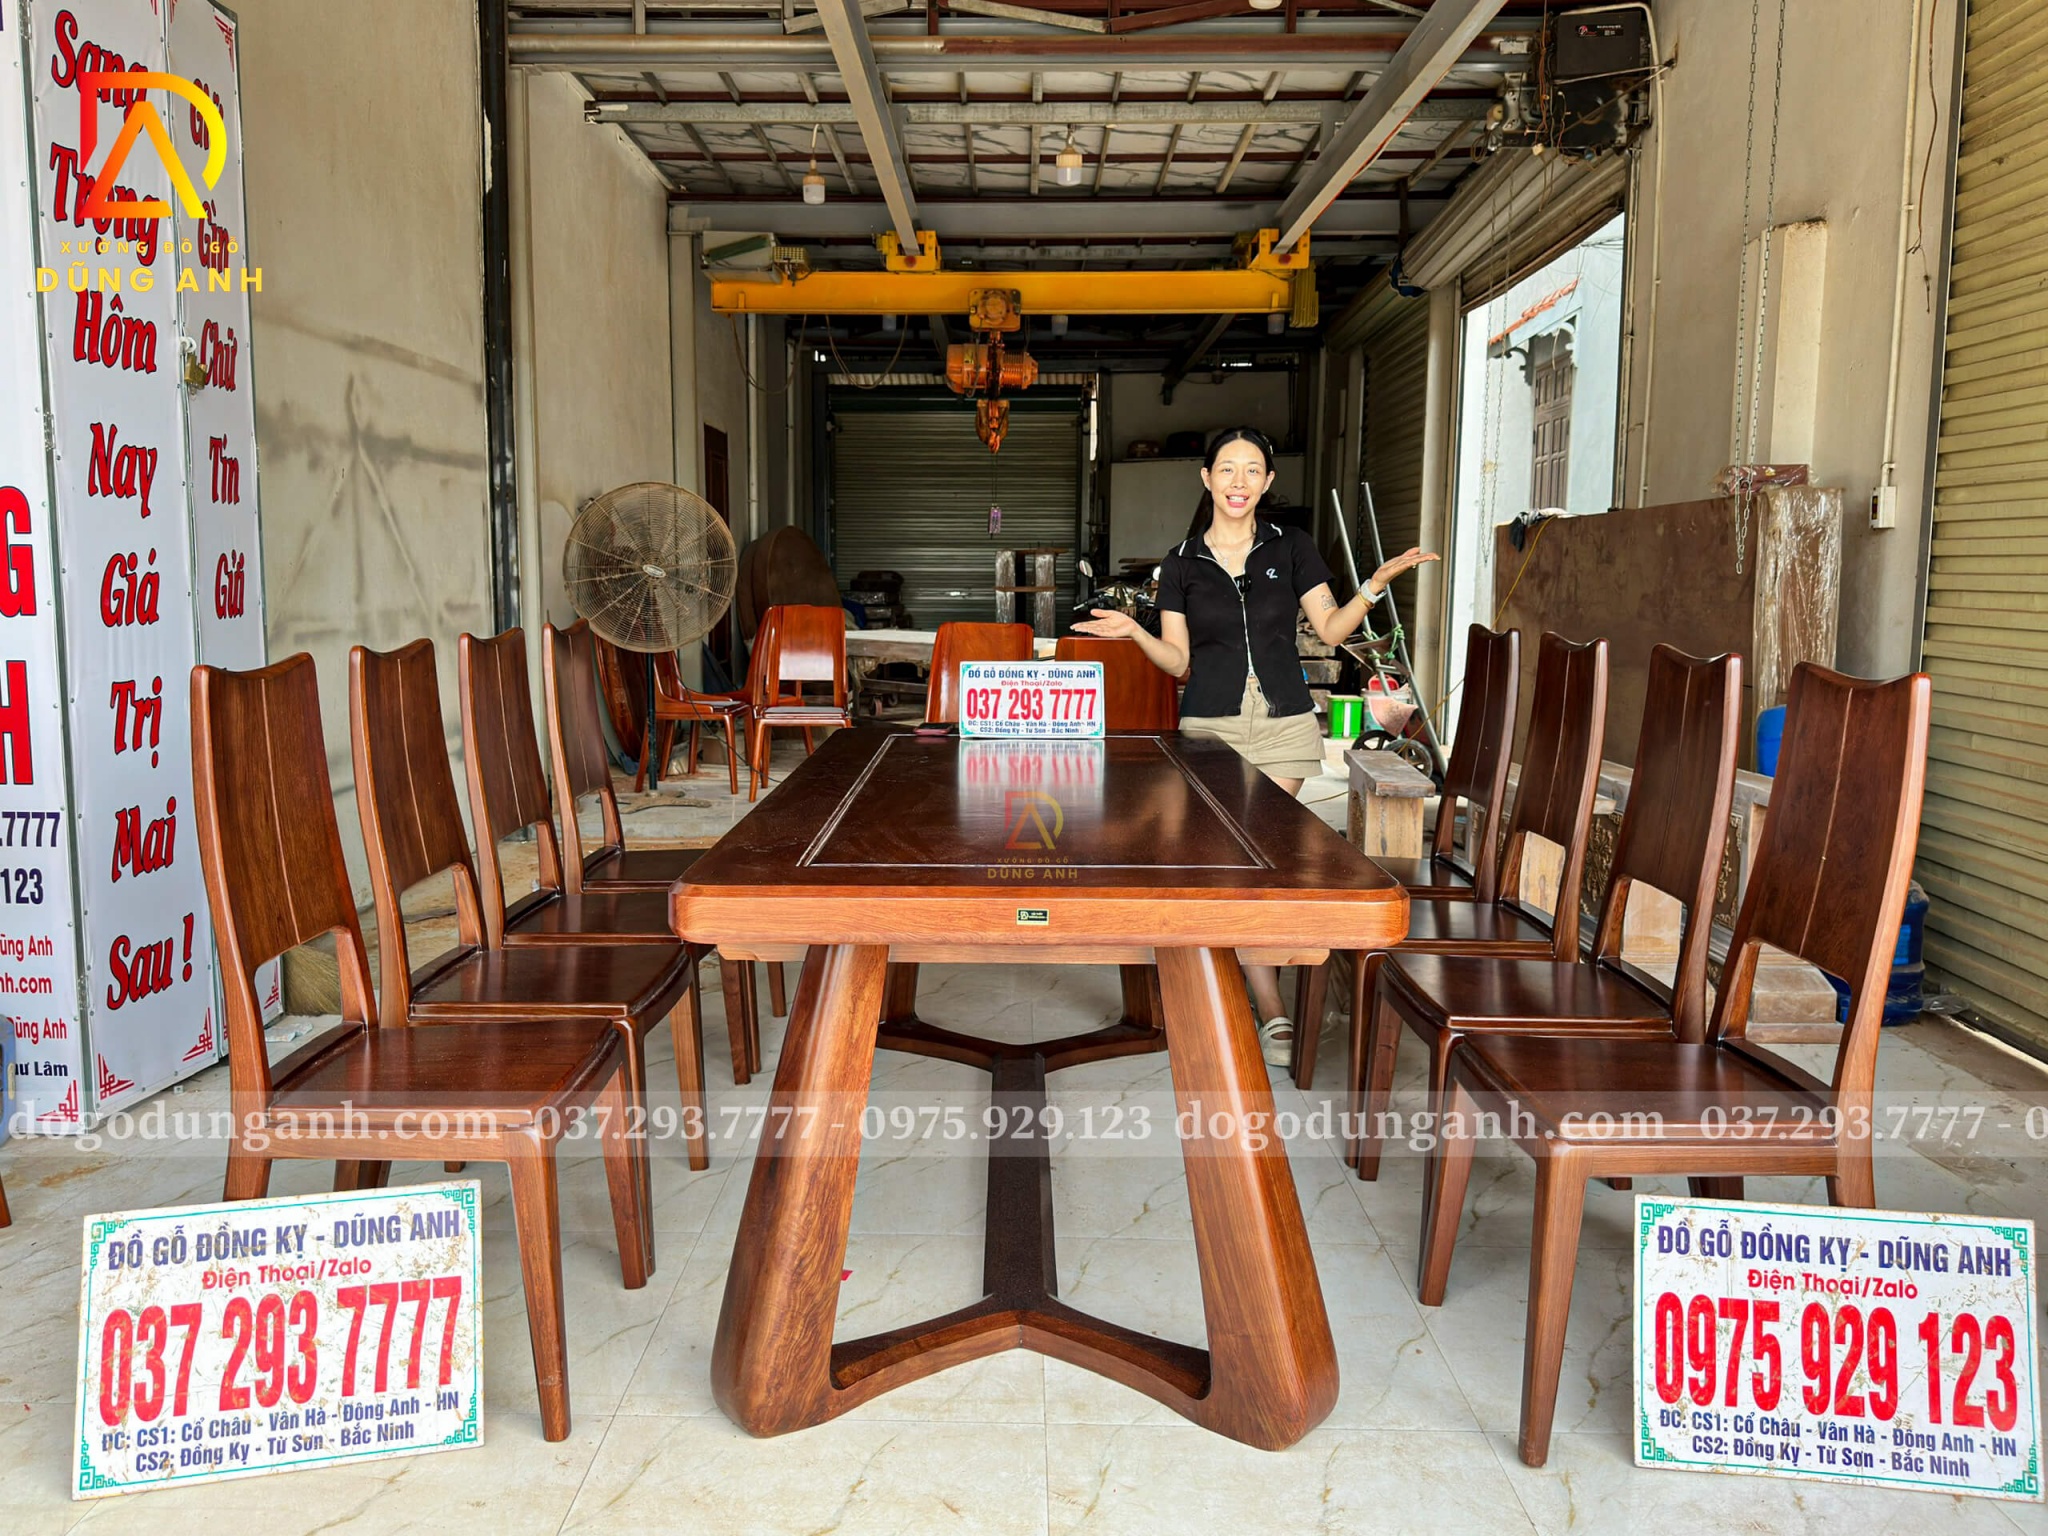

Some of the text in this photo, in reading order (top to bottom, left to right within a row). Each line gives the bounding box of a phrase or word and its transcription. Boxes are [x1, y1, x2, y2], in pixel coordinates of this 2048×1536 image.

[190, 78, 224, 151] Gi
[74, 288, 157, 374] Hôm
[88, 422, 158, 519] Nay
[209, 434, 241, 505] Tín
[100, 547, 160, 628] Giá
[967, 688, 1097, 720] 037 293 7777
[1076, 670, 1096, 679] ANH
[110, 675, 163, 769] Trị
[111, 796, 177, 883] Mai
[0, 868, 43, 905] 123
[28, 935, 53, 956] Anh
[6, 1016, 67, 1045] ũng Anh
[34, 1061, 68, 1077] Lâm
[108, 1229, 143, 1270] ĐỒ
[153, 1224, 188, 1266] GỖ
[196, 1221, 267, 1262] ĐỒNG
[276, 1224, 308, 1259] KỴ
[334, 1212, 401, 1249] DŨNG
[410, 1209, 460, 1241] ANH
[1657, 1217, 1690, 1255] ĐỒ
[1700, 1219, 1732, 1258] GỖ
[1740, 1223, 1810, 1263] ĐỒNG
[1819, 1236, 1851, 1272] KỴ
[1878, 1235, 1949, 1273] DŨNG
[1957, 1245, 2011, 1277] ANH
[202, 1256, 372, 1293] Điện Thoại/Zalo
[1747, 1269, 1918, 1300] Điện Thoại/Zalo
[99, 1276, 462, 1427] 037 293 7777
[1655, 1292, 2018, 1432] 0975 929 123
[102, 1431, 131, 1451] ĐC:
[137, 1426, 175, 1447] CS1:
[181, 1417, 205, 1442] Cổ
[209, 1416, 252, 1439] Châu
[269, 1411, 300, 1432] Vân
[305, 1407, 326, 1427] Hà
[343, 1402, 384, 1422] Đông
[390, 1396, 420, 1417] Anh
[436, 1391, 459, 1412] HN
[136, 1450, 175, 1472] CS2:
[180, 1443, 223, 1467] Đồng
[267, 1434, 287, 1456] Từ
[292, 1434, 323, 1453] Sơn
[341, 1422, 372, 1447] Bắc
[377, 1420, 415, 1442] Ninh
[1692, 1411, 1728, 1432] CS1:
[1734, 1412, 1755, 1434] Cổ
[1759, 1416, 1800, 1438] Châu
[1817, 1421, 1848, 1442] Vân
[1854, 1424, 1875, 1444] Hà
[1892, 1427, 1936, 1451] Đông
[1942, 1432, 1974, 1453] Anh
[1992, 1436, 2017, 1457] HN
[1692, 1435, 1728, 1455] CS2:
[1733, 1437, 1775, 1461] Đồng
[1816, 1444, 1837, 1466] Từ
[1842, 1447, 1873, 1468] Sơn
[1891, 1449, 1924, 1473] Bắc
[1930, 1454, 1970, 1478] Ninh
